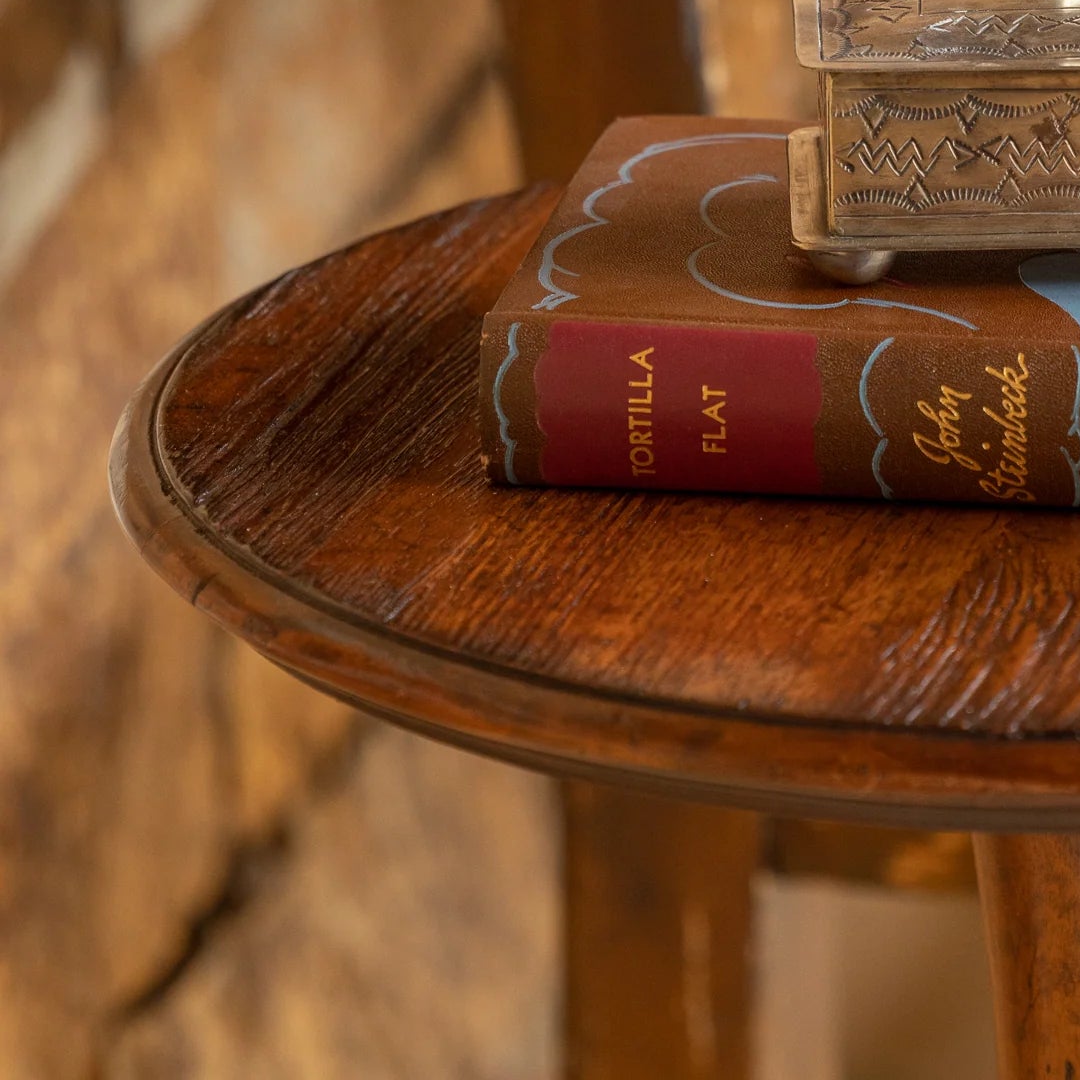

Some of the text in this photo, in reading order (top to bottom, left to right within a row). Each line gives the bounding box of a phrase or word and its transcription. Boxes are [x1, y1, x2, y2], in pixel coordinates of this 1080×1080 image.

[628, 346, 656, 477] TORTILLA
[701, 384, 728, 454] FLAT
[912, 384, 982, 472] John
[978, 352, 1037, 503] Steinbeck
